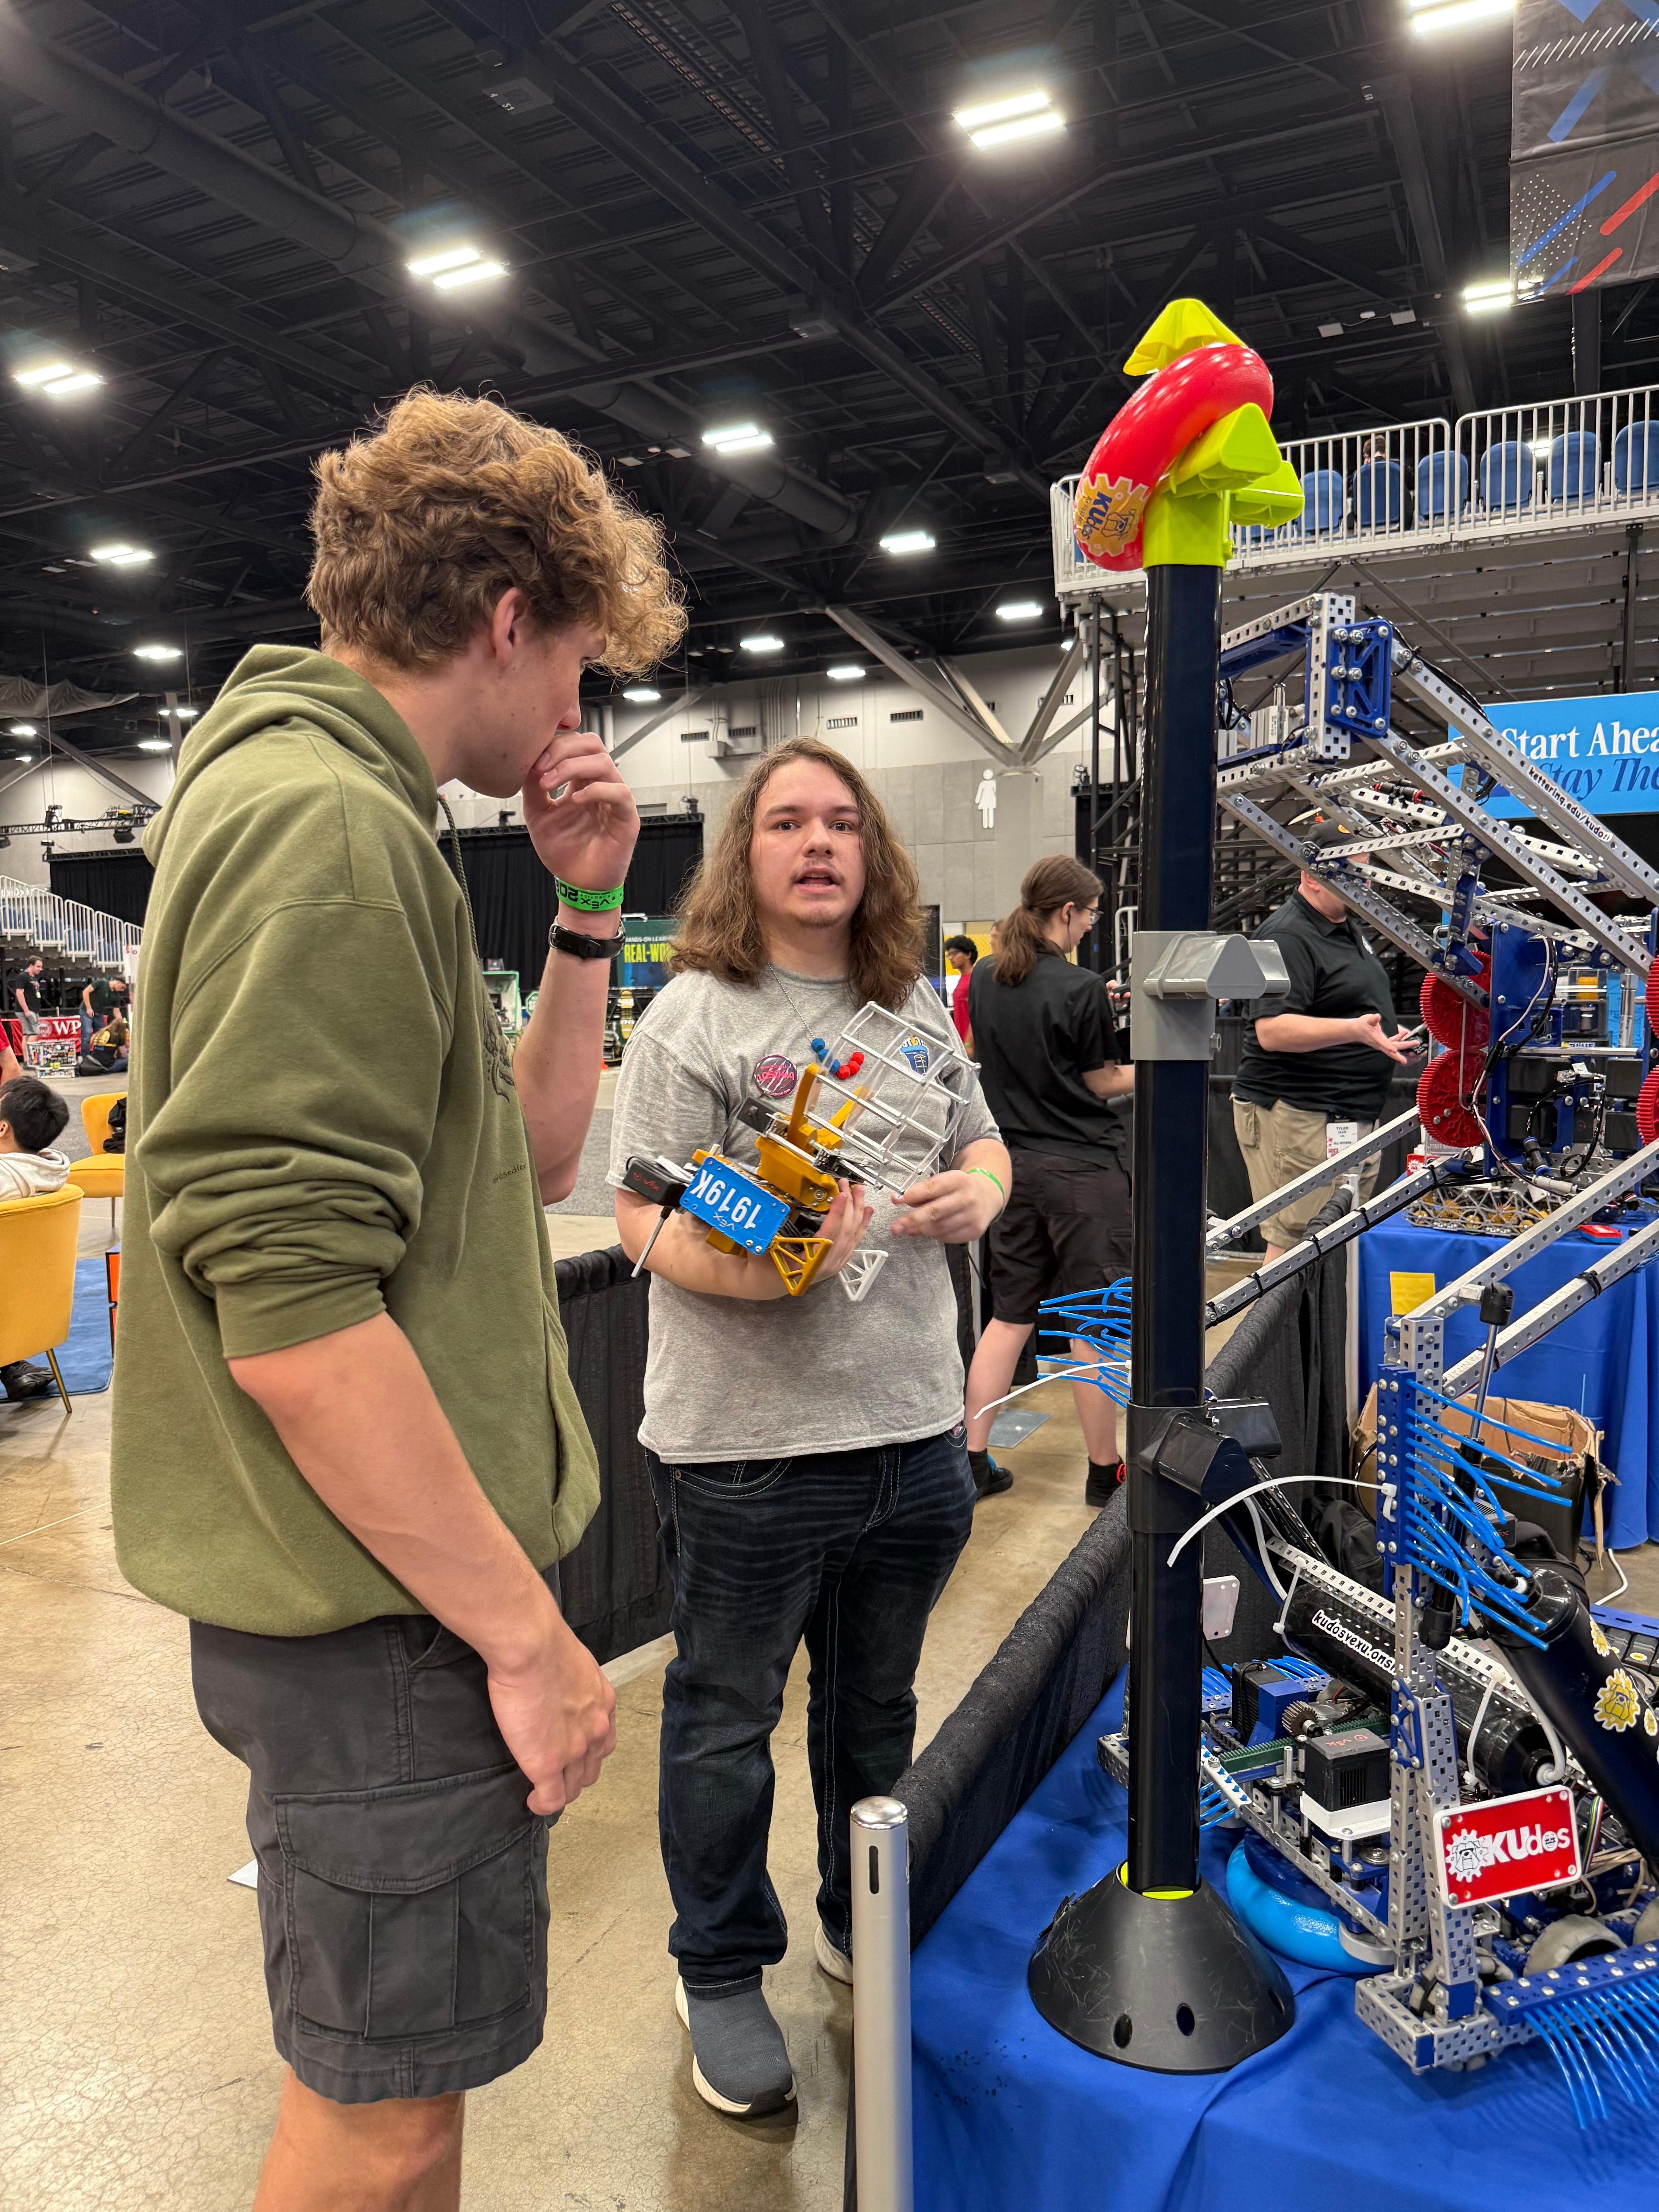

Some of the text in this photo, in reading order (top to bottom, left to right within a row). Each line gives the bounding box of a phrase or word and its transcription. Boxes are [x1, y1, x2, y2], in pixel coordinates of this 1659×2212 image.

[1082, 491, 1113, 539] KUdos
[1501, 726, 1580, 760] Start
[580, 897, 610, 909] VEX
[690, 1170, 762, 1229] 1919K
[713, 1212, 735, 1231] VEX
[1482, 1824, 1570, 1867] KUdos
